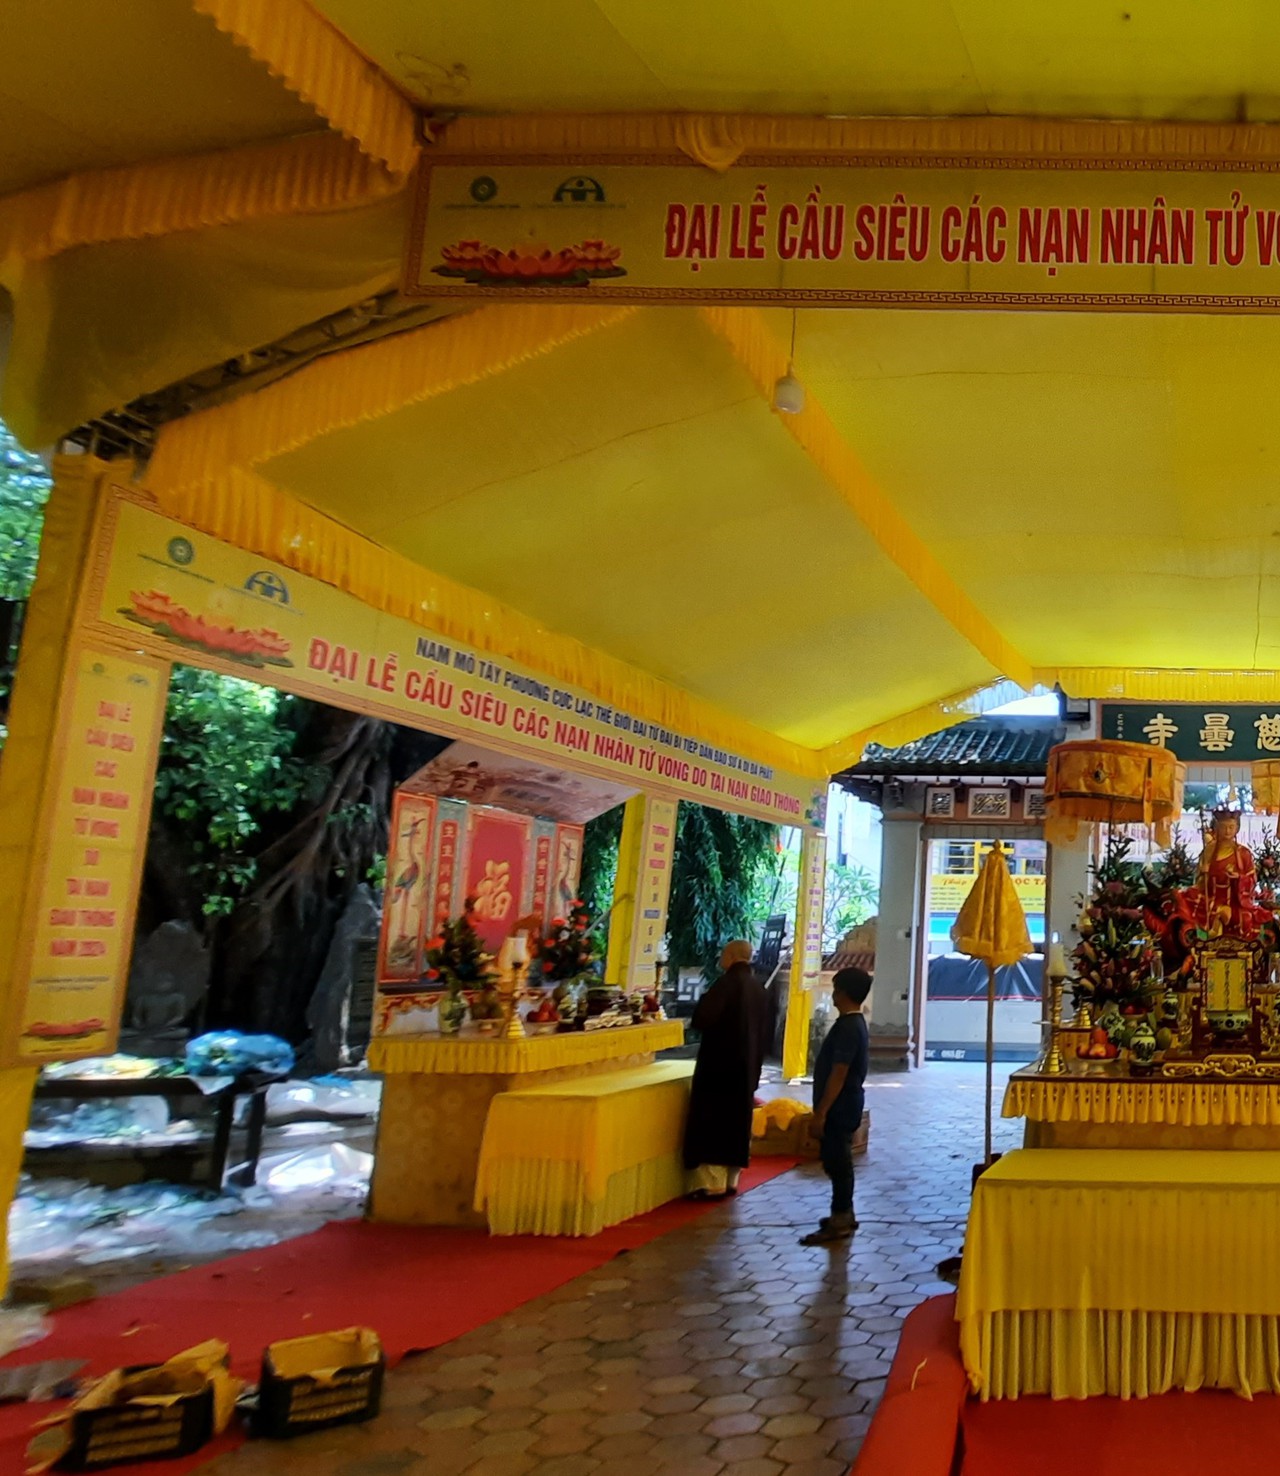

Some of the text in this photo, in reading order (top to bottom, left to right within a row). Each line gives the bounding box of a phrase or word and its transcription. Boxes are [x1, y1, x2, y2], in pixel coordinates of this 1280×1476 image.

[664, 203, 721, 272] ĐẠI
[728, 184, 768, 260] LỄ
[776, 184, 846, 261] CẦU
[853, 193, 931, 262] SIÊU
[940, 194, 1008, 263] CÁC
[1016, 207, 1090, 276] NẠN
[1099, 196, 1195, 265] NHÂN
[1204, 190, 1250, 266] TỬ
[416, 637, 451, 665] NAM
[453, 650, 476, 675] MÔ
[478, 659, 502, 684] TÂY
[308, 637, 360, 683] ĐẠI
[365, 654, 398, 693] LỄ
[459, 689, 508, 727] SIÊU
[512, 707, 550, 740] CÁC
[554, 720, 590, 753] NẠN
[593, 734, 635, 767] NHÂN
[638, 745, 656, 772] TỬ
[658, 755, 690, 783] VONG
[691, 766, 707, 787] DO
[710, 772, 727, 793] TAI
[727, 778, 749, 801] NẠN
[750, 785, 772, 806] GIAO
[774, 791, 801, 815] THÔNG
